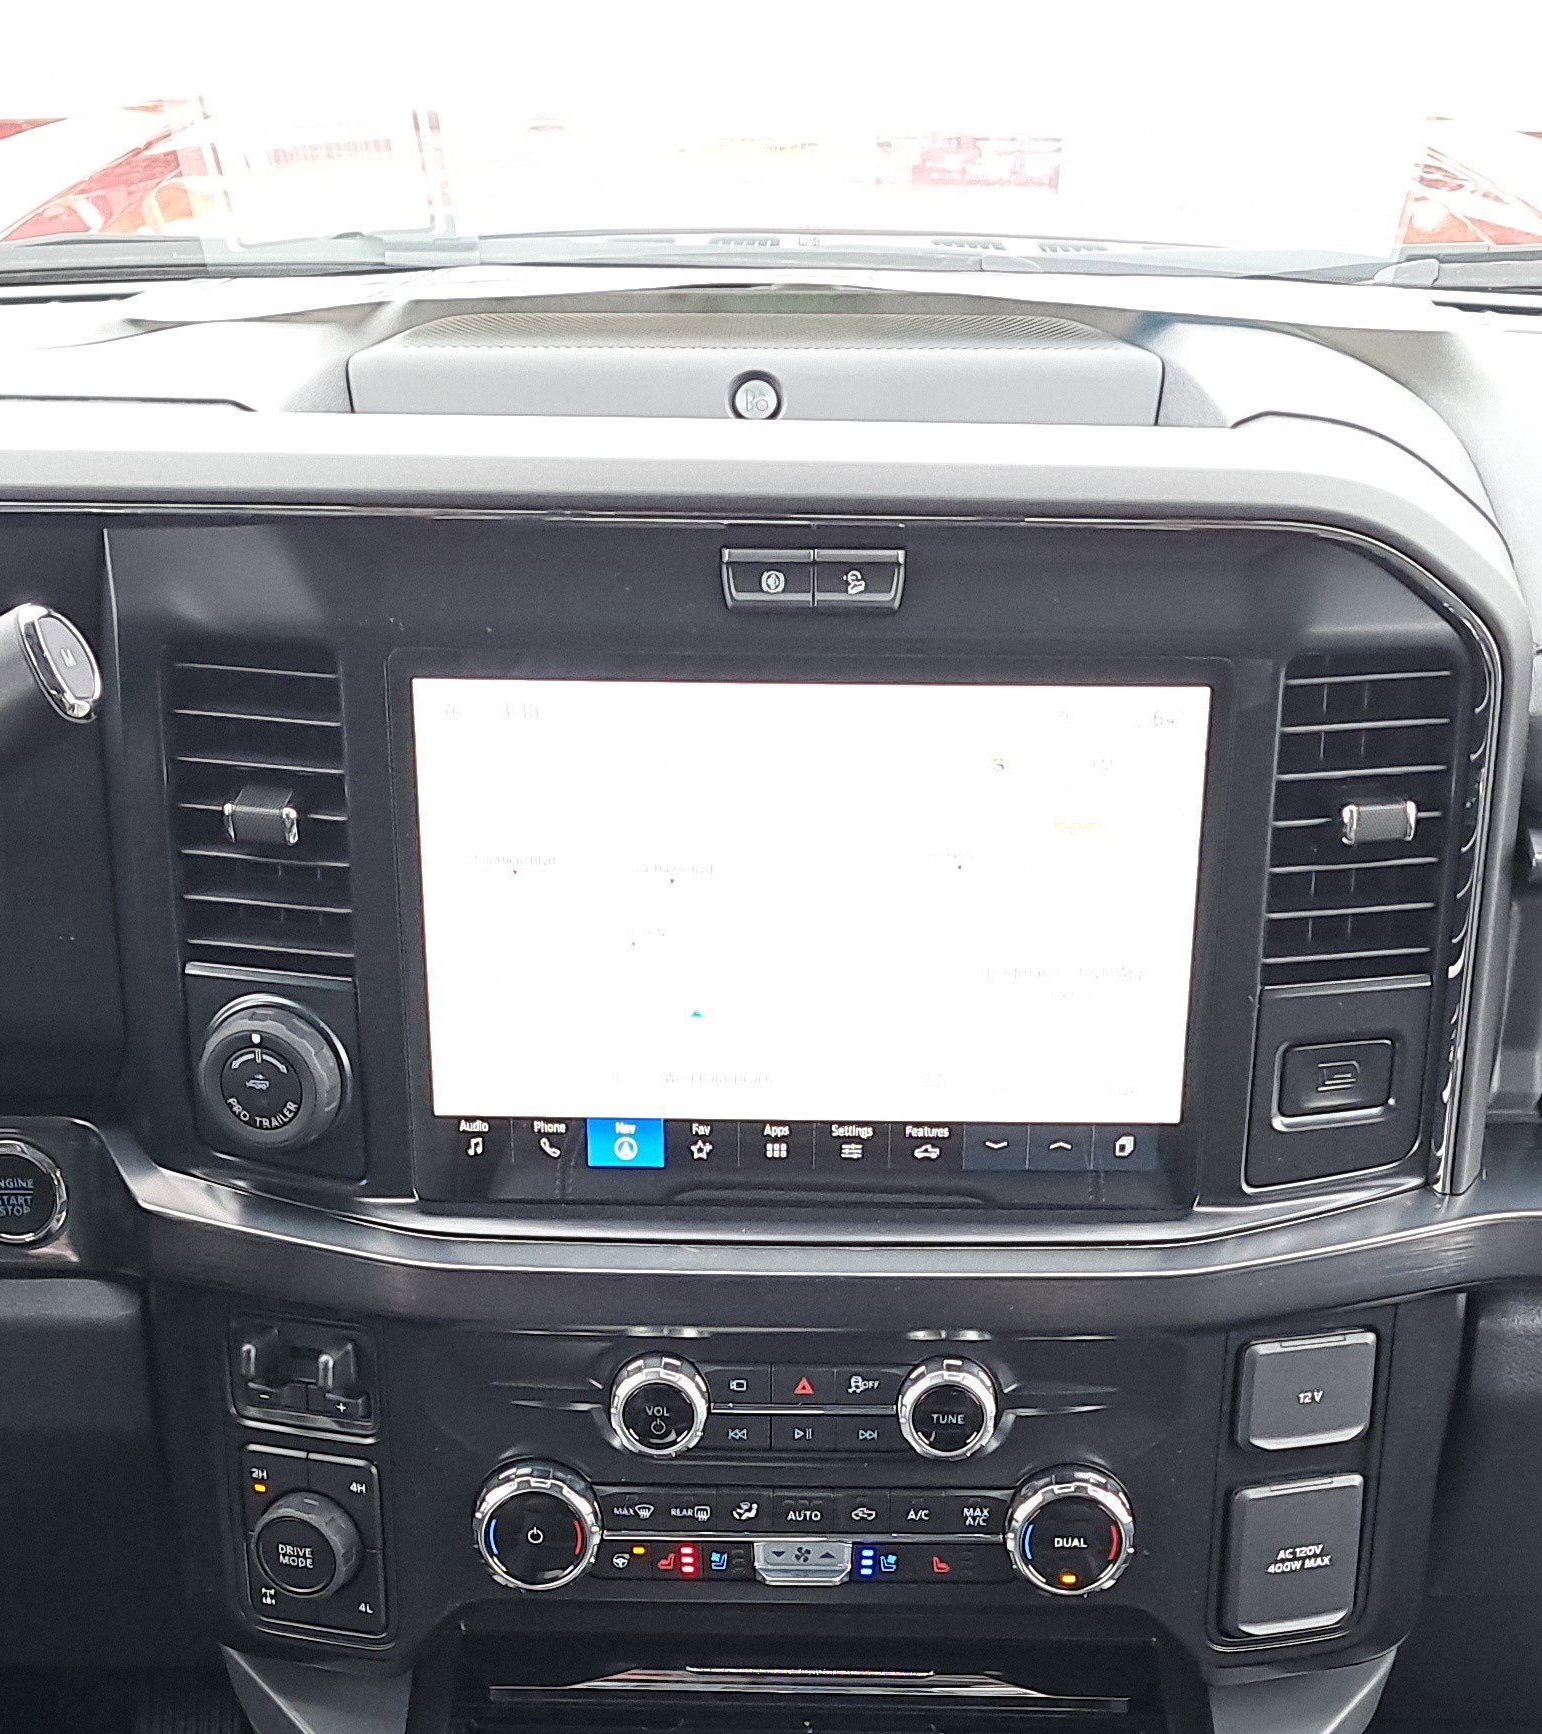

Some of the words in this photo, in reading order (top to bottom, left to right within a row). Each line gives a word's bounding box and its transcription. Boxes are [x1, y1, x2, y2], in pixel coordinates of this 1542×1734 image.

[227, 1098, 250, 1122] PRO
[255, 1101, 299, 1128] TRAILER
[459, 1119, 489, 1133] Audio
[533, 1120, 566, 1134] Phone
[615, 1122, 636, 1134] Nav
[692, 1123, 711, 1136] Fav
[764, 1123, 790, 1138] Apps
[830, 1123, 874, 1139] Settings
[905, 1125, 950, 1138] Features
[0, 1205, 31, 1217] STOP
[862, 1380, 880, 1390] OFF
[1298, 1391, 1312, 1404] 12
[645, 1405, 670, 1417] VOL
[931, 1413, 965, 1425] TUNE
[250, 1467, 268, 1480] 2H
[349, 1481, 366, 1494] 4H
[613, 1506, 635, 1516] MAX
[670, 1507, 694, 1517] REAR
[787, 1510, 821, 1521] AUTO
[907, 1508, 930, 1520] A/C
[963, 1507, 990, 1518] MAX
[965, 1516, 987, 1526] A/C
[1054, 1537, 1088, 1548] DUAL
[278, 1543, 313, 1558] DRIVE
[1277, 1548, 1294, 1560] AC
[1295, 1544, 1323, 1558] 120V
[279, 1555, 313, 1568] MODE
[1266, 1559, 1302, 1573] 400W
[1304, 1555, 1331, 1568] MAX
[358, 1602, 374, 1614] 4L
